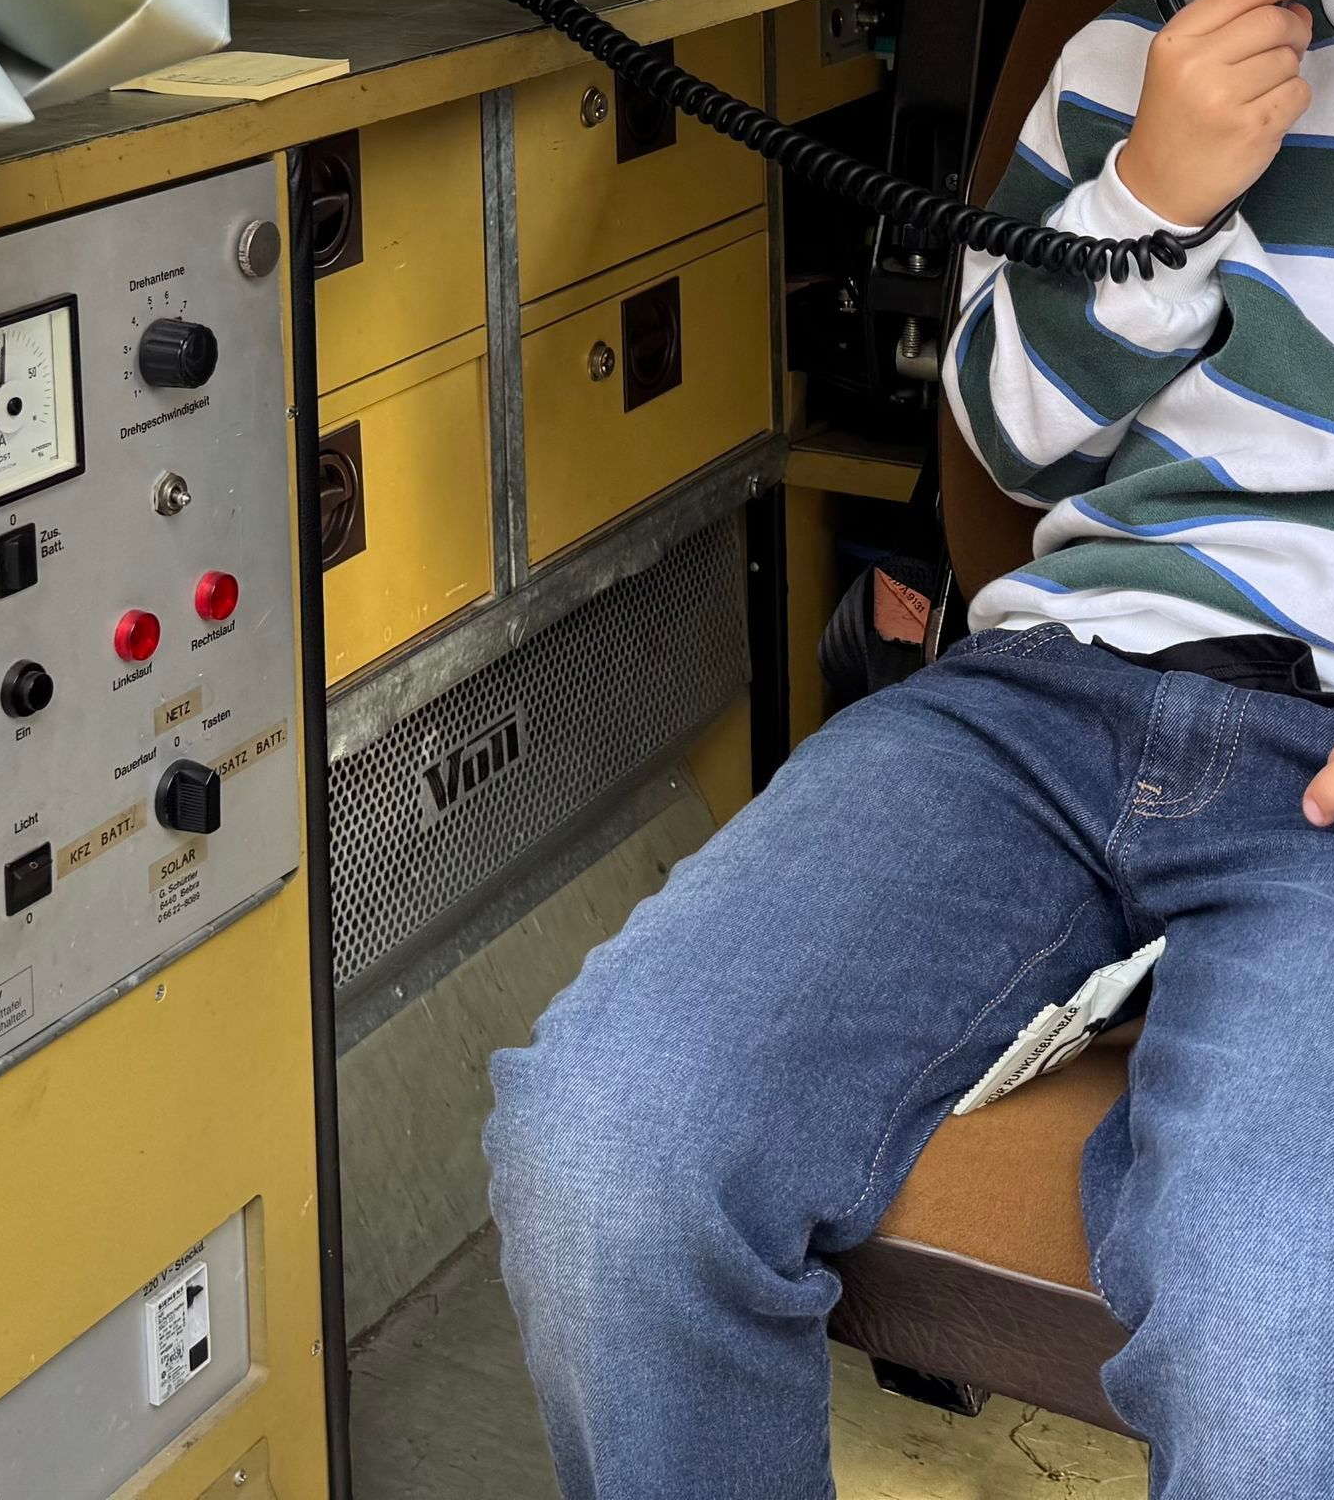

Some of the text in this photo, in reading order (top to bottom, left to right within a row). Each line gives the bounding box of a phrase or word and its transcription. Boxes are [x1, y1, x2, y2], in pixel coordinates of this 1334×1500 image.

[129, 265, 185, 292] Drehantenne
[147, 296, 153, 305] 5
[28, 366, 37, 379] 50
[120, 395, 210, 439] Drehgeschwindigkeit
[10, 514, 16, 525] 0
[40, 526, 61, 543] Zus.
[41, 539, 65, 559] Batt.
[191, 619, 235, 651] Rechtslauf
[112, 662, 153, 691] Linkslauf
[166, 701, 191, 724] NETZ
[202, 709, 231, 731] Tasten
[16, 726, 31, 742] Ein
[174, 736, 180, 747] 0
[114, 747, 157, 780] Dauerlauf
[213, 730, 285, 777] USATZ BATT.
[14, 812, 39, 835] Licht
[70, 817, 135, 865] KFZ BATT.
[161, 848, 196, 879] SOLAR
[26, 912, 33, 924] 0
[143, 1277, 158, 1298] 220
